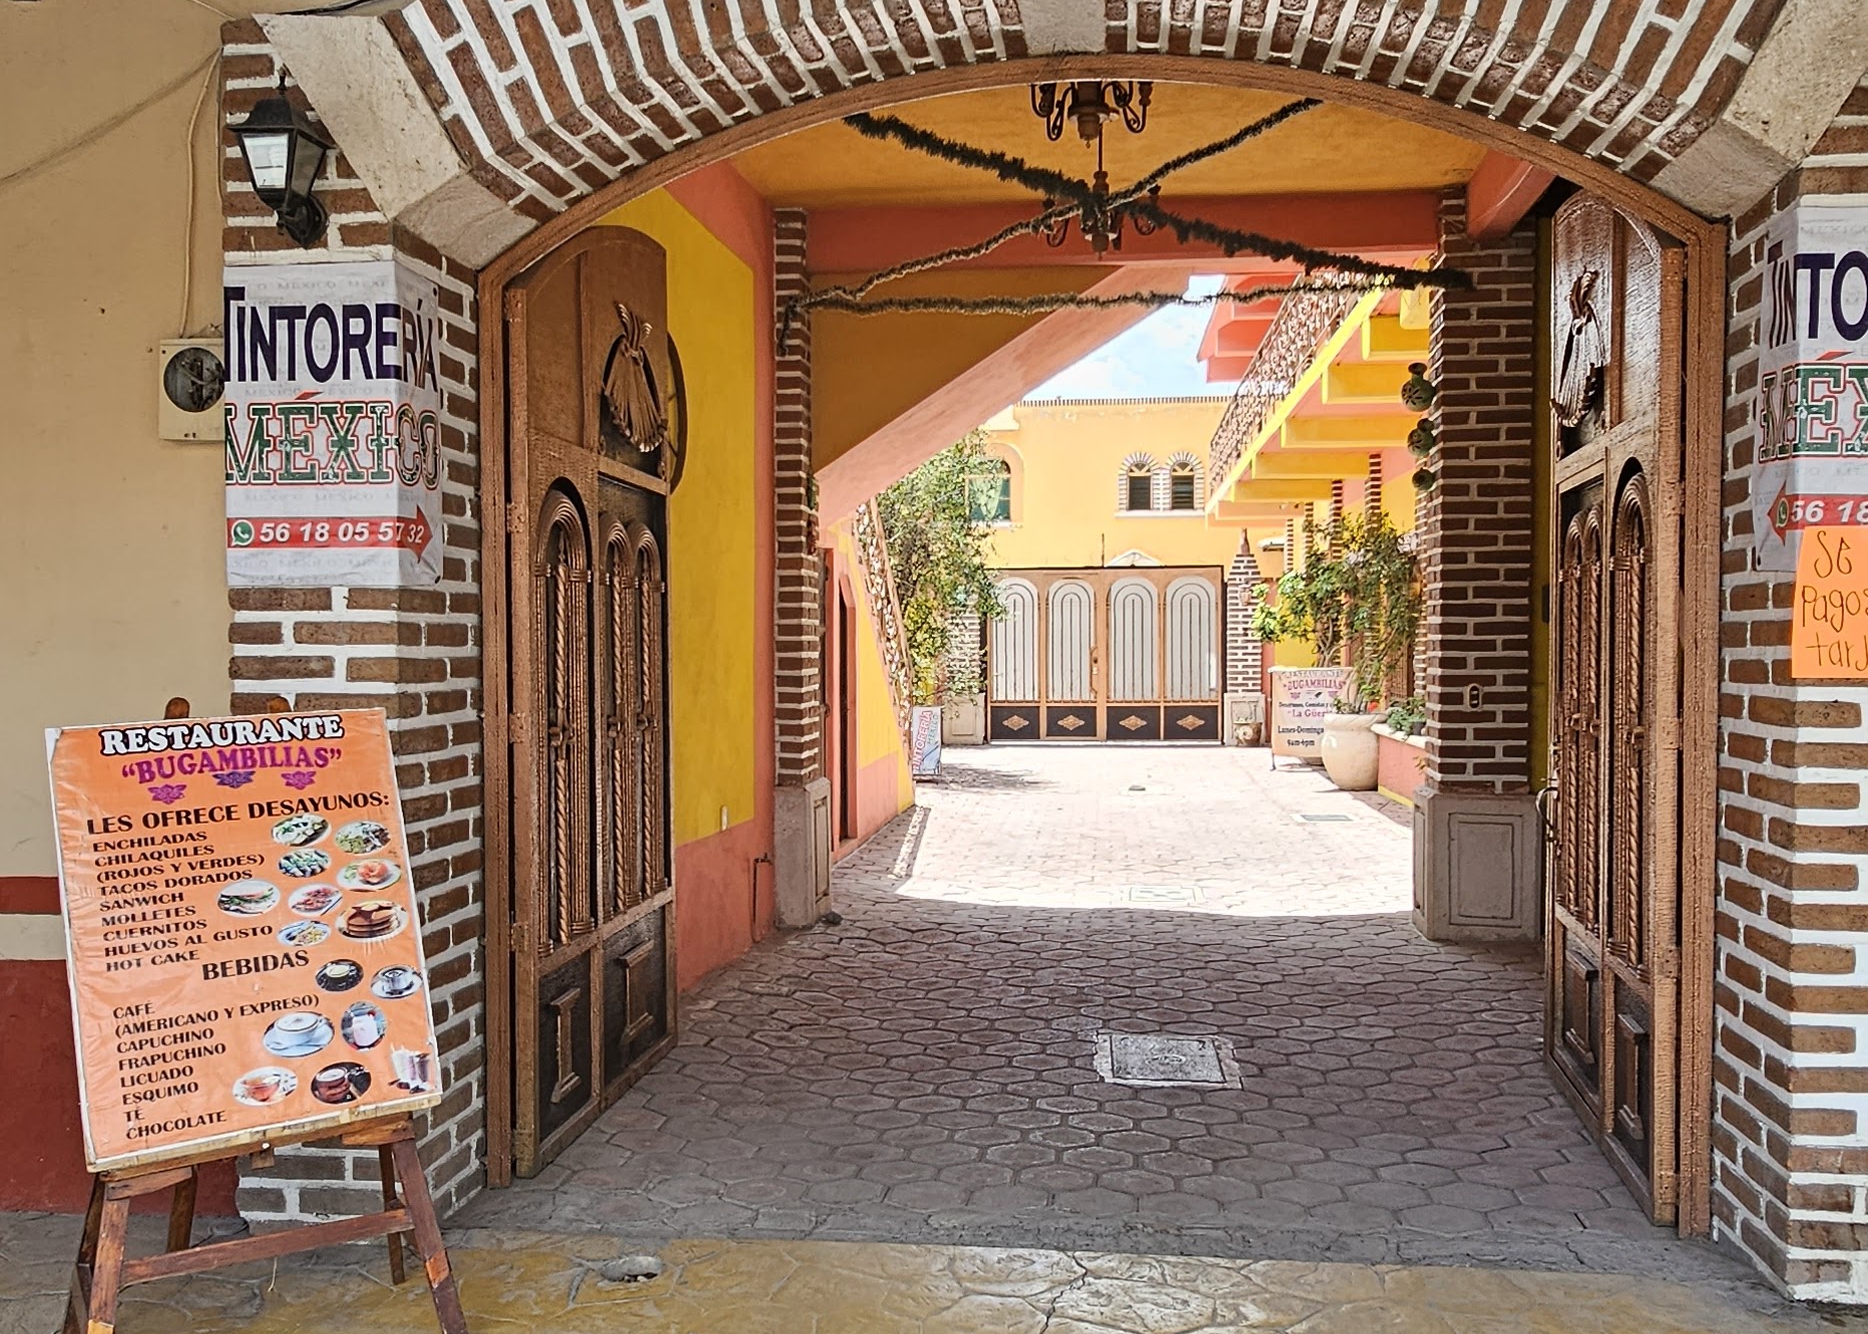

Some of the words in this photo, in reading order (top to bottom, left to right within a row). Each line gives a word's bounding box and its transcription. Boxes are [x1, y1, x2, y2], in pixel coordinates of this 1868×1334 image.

[224, 286, 438, 393] TINTORERÍA
[225, 390, 441, 491] MÉXICO
[1791, 501, 1825, 523] 56
[260, 523, 290, 542] 56
[300, 522, 330, 542] 18
[338, 522, 370, 542] 05
[378, 522, 404, 542] 57
[407, 523, 425, 544] 32
[99, 715, 344, 757] RESTAURANTE
[87, 815, 133, 835] LES
[142, 805, 241, 830] OFRECE
[247, 791, 390, 819] DESAYUNOS:
[92, 831, 208, 853] ENCHILADAS
[94, 845, 215, 867] CHILAQUILES
[96, 865, 165, 884] (ROJOS
[171, 863, 182, 873] Y
[186, 853, 265, 869] VERDES)
[100, 879, 158, 897] TACOS
[164, 869, 253, 889] DORADOS
[100, 892, 184, 912] SANWICH
[101, 905, 196, 927] MOLLETES
[102, 919, 208, 942] CUERNITOS
[104, 937, 179, 957] HUEVOS
[184, 934, 208, 947] AL
[212, 925, 274, 942] GUSTO
[105, 957, 142, 972] HOT
[150, 949, 200, 966] CAKE
[202, 949, 310, 981] BEBIDAS
[112, 1000, 156, 1019] CAFÉ
[114, 1010, 219, 1039] (AMERICANO
[224, 1007, 236, 1019] Y
[240, 993, 320, 1016] EXPRESO)
[116, 1027, 214, 1053] CAPUCHINO
[118, 1043, 226, 1071] FRAPUCHINO
[120, 1065, 194, 1088] LICUADO
[122, 1081, 199, 1105] ESQUIMO
[124, 1105, 146, 1123] TÉ
[125, 1110, 227, 1141] CHOCOLATE
